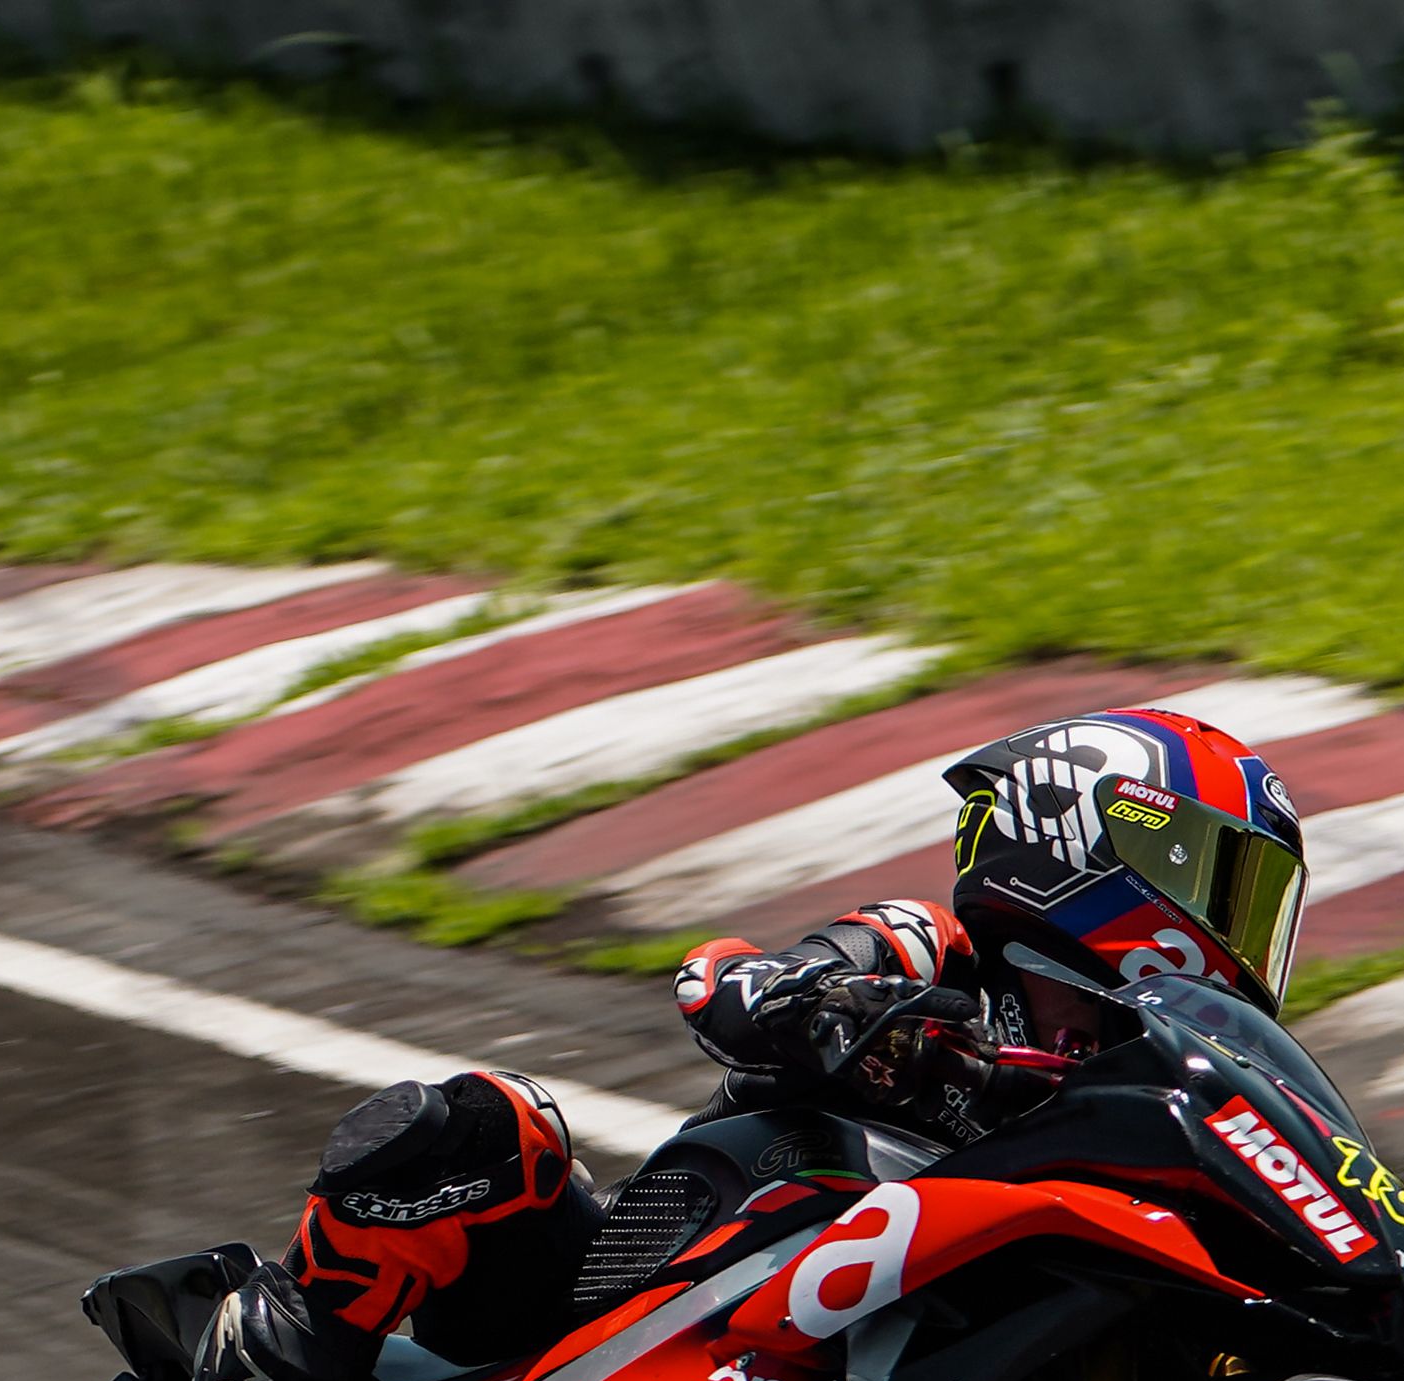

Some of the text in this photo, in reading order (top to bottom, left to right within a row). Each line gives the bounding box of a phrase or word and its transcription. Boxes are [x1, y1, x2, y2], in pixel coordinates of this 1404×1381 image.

[1117, 781, 1176, 810] MOTUL
[999, 993, 1027, 1046] alpine
[342, 1179, 491, 1222] alpinestars
[1213, 1111, 1364, 1254] MOTUL
[789, 1182, 921, 1339] a
